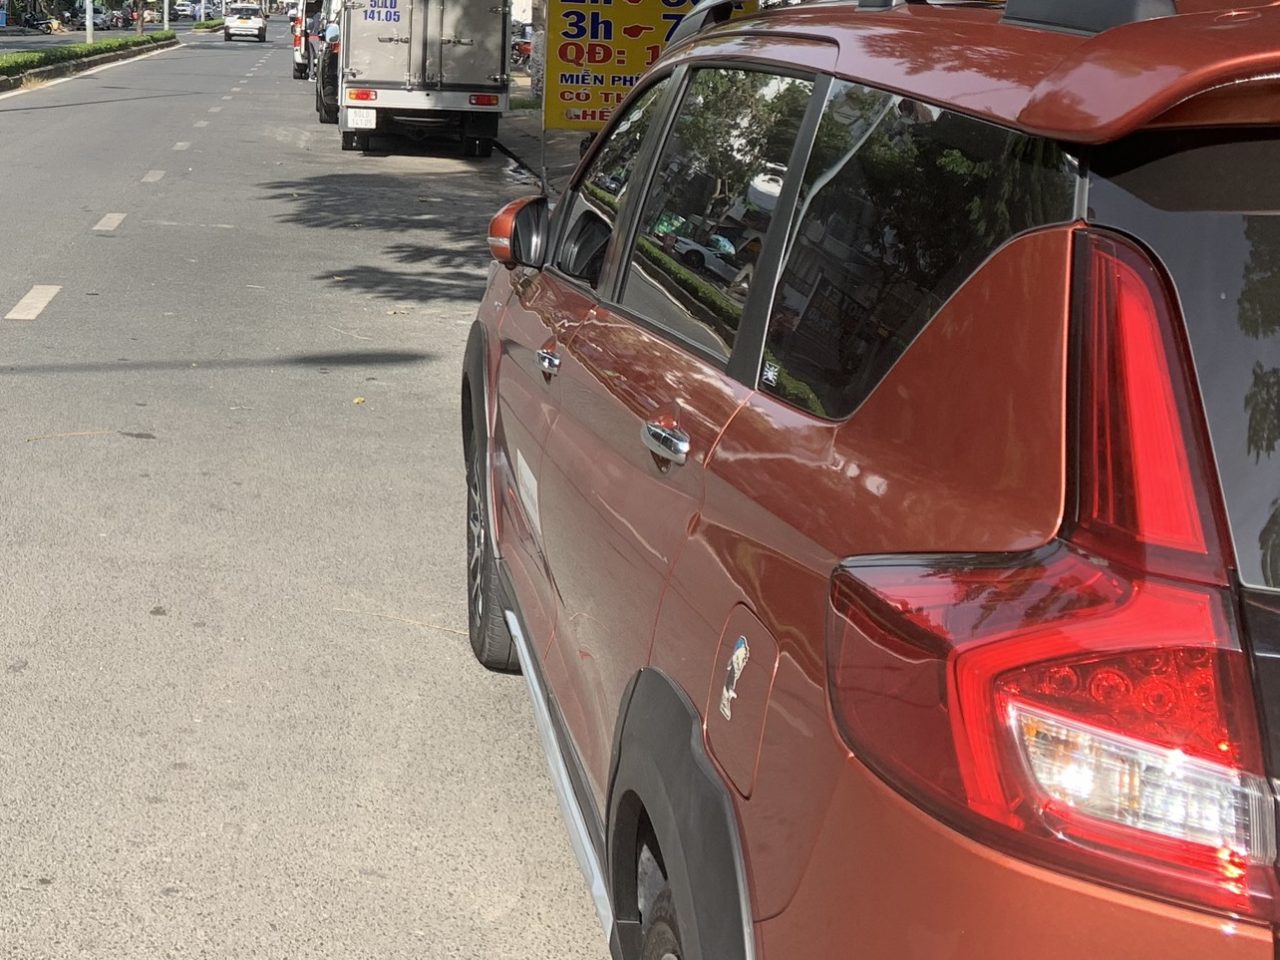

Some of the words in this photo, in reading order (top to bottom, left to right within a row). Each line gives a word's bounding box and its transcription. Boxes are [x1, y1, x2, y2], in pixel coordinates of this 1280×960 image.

[363, 9, 401, 23] 141.05
[561, 10, 613, 40] 3h
[662, 14, 687, 41] 7
[558, 42, 626, 66] QĐ:
[646, 45, 660, 66] 1
[560, 69, 604, 85] MIỄN
[559, 88, 591, 102] CÓ
[600, 92, 625, 103] TH
